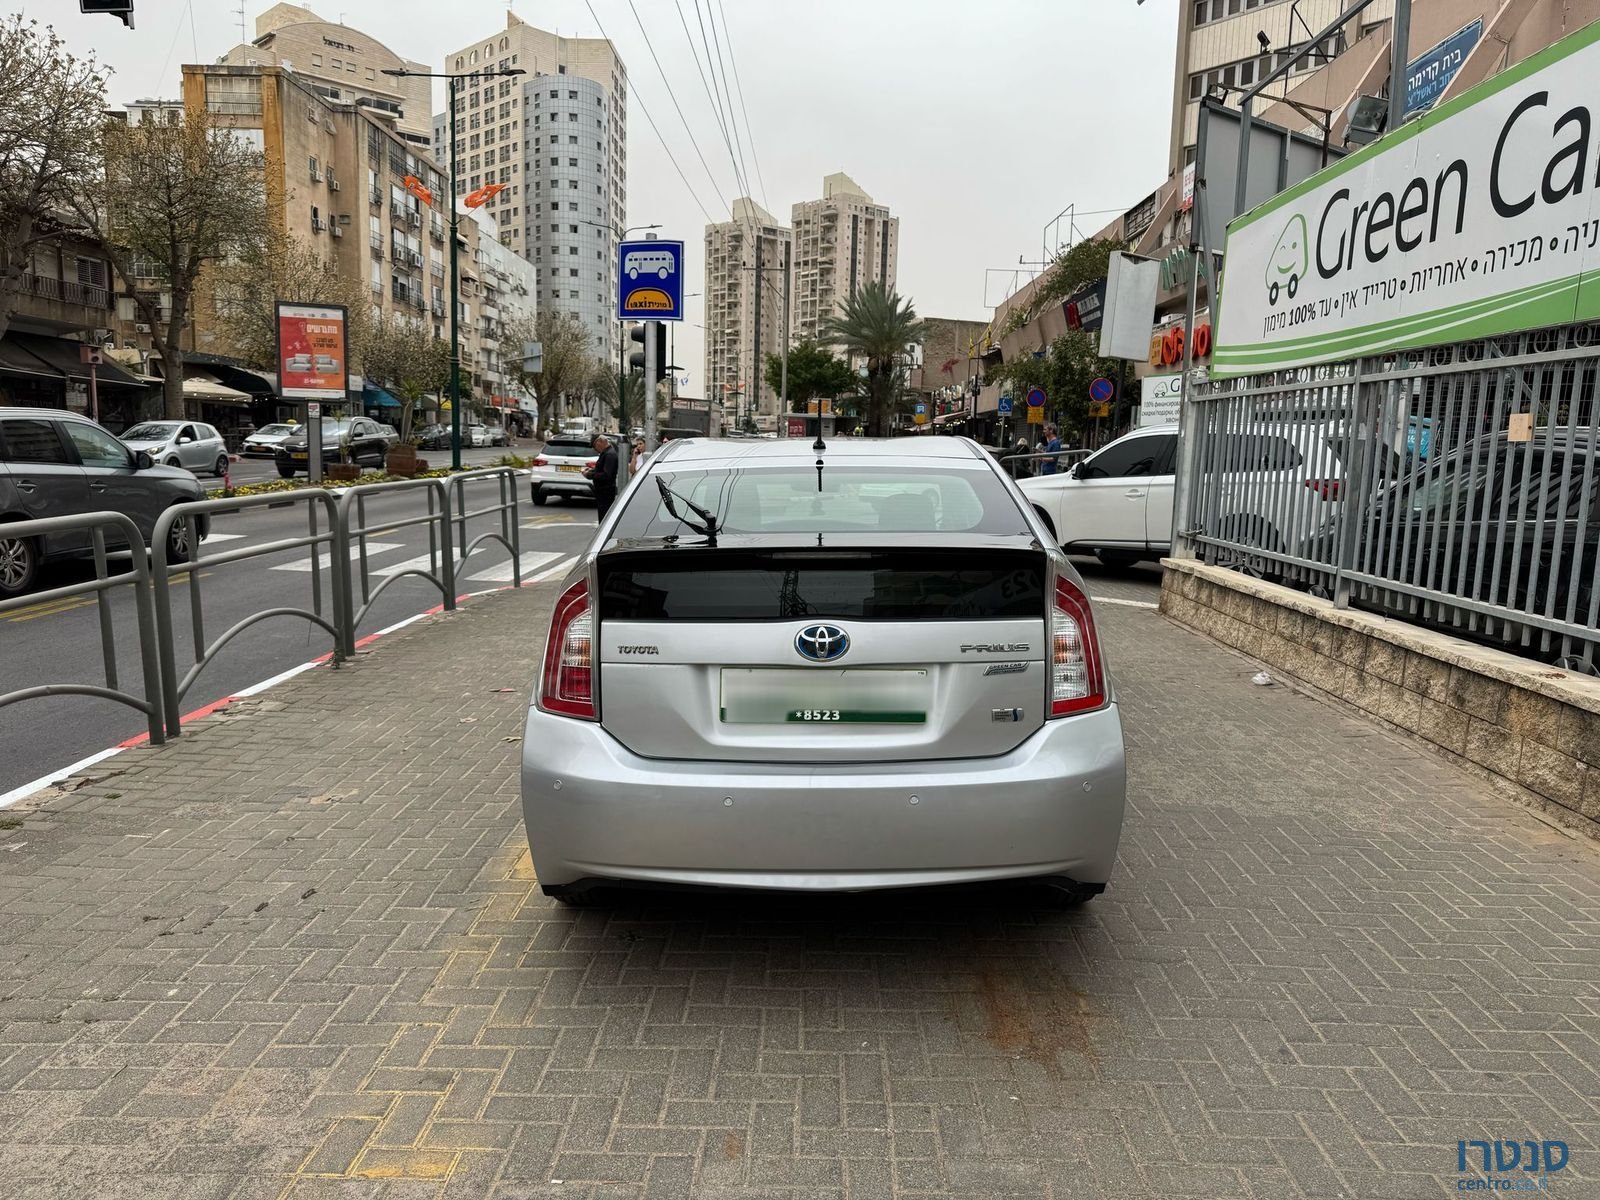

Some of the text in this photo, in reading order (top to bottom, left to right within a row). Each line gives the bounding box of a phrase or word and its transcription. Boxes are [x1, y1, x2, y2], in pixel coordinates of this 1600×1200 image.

[1408, 48, 1461, 91] בית קדימה
[1316, 90, 1600, 279] Green Ca
[1483, 235, 1543, 275] מכירה
[1409, 257, 1468, 294] אחריות
[1341, 288, 1359, 318] אין
[1363, 277, 1397, 306] טרייד
[1288, 302, 1316, 327] 100%
[1318, 297, 1332, 318] עד
[1263, 312, 1286, 338] מימון
[617, 645, 659, 655] TOYOTA
[960, 643, 1031, 653] PRIUS
